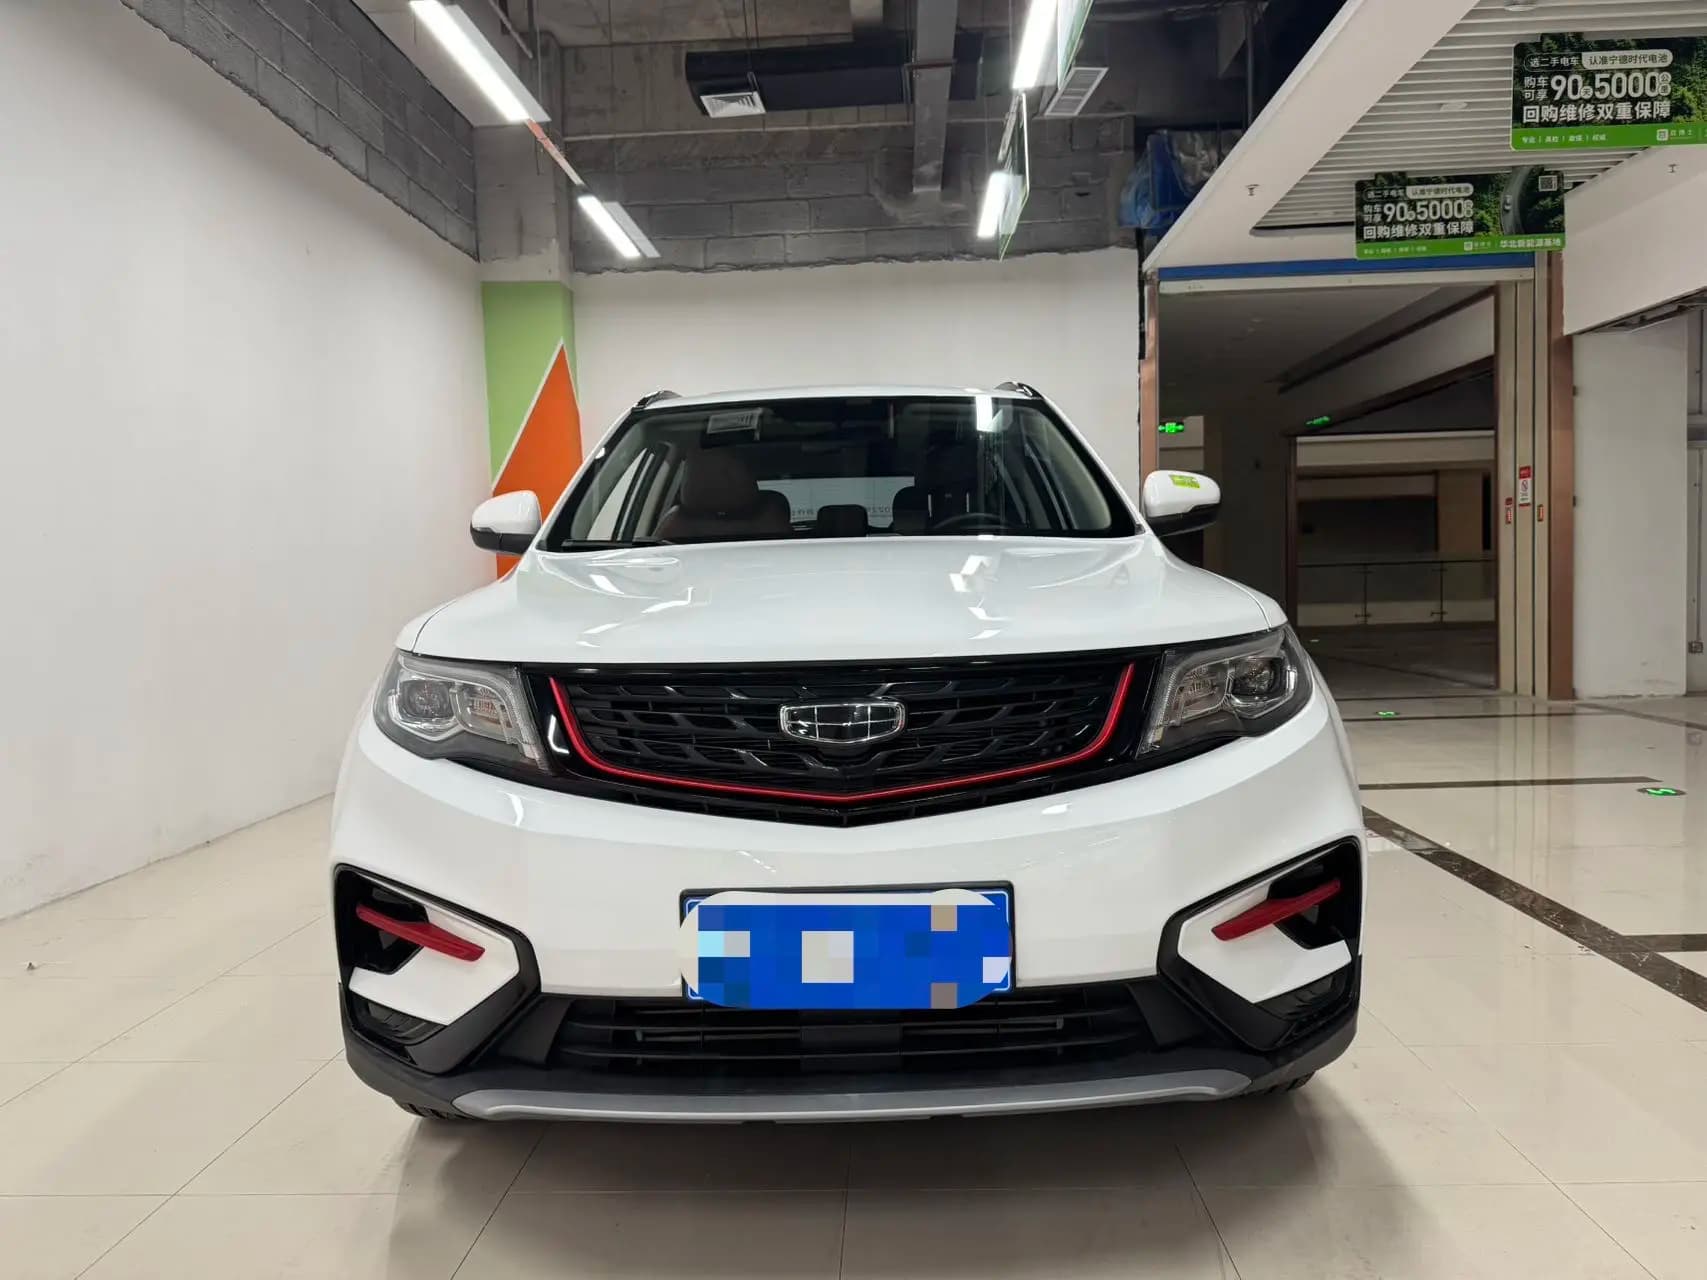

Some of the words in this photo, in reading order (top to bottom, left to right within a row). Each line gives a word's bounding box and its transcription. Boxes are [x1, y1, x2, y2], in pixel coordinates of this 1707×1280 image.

[1588, 53, 1669, 65] 认准宁德时代电池
[1522, 100, 1671, 124] 回购维修双重保障
[1363, 220, 1474, 240] 回购维修双重保障
